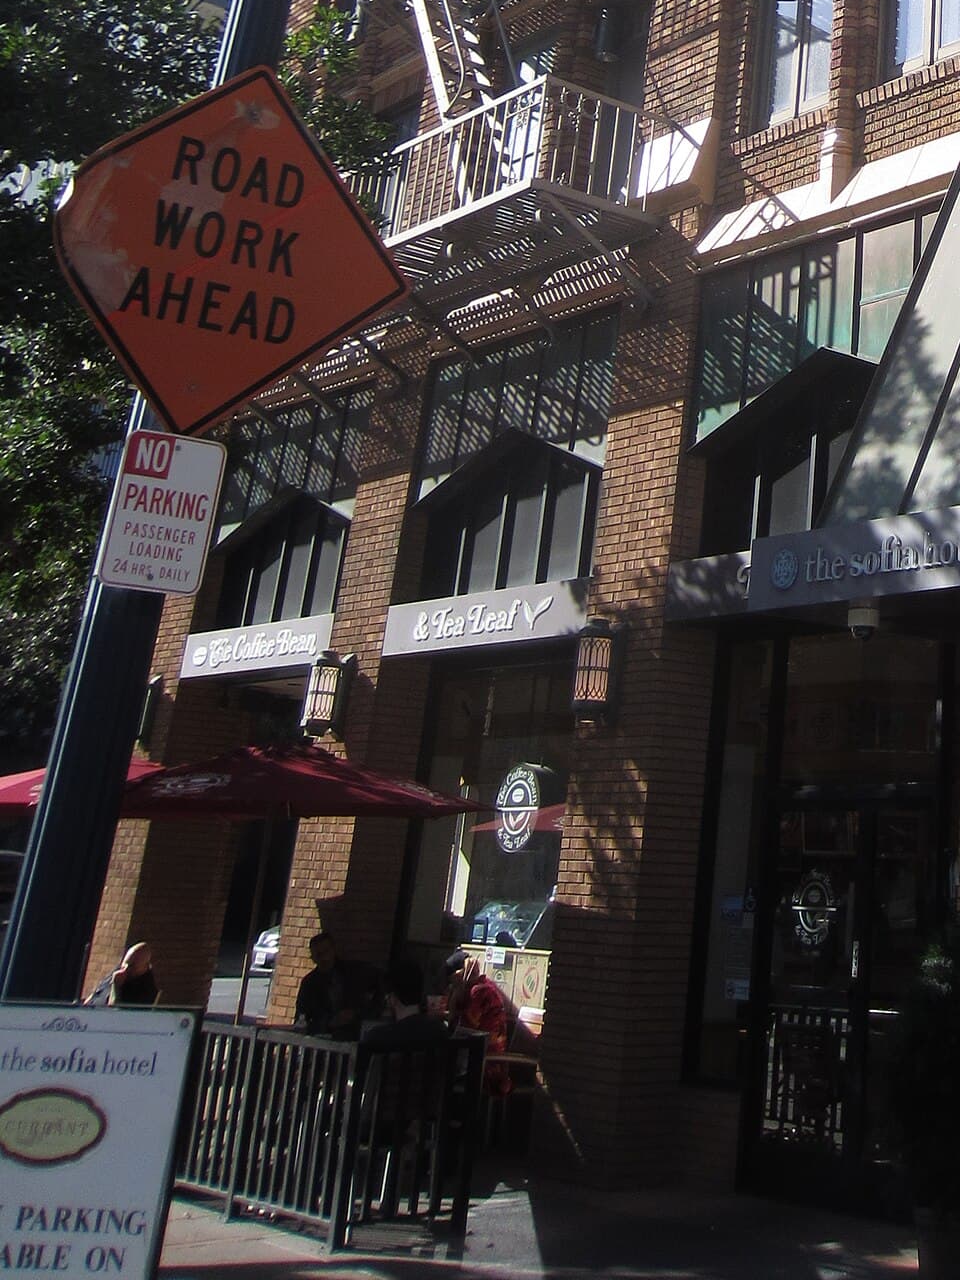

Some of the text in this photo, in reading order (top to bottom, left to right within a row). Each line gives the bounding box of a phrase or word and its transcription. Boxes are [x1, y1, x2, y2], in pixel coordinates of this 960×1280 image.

[171, 136, 305, 209] ROAD
[154, 199, 299, 278] WORK
[119, 267, 296, 345] AHEAD
[135, 438, 171, 473] NO
[123, 484, 209, 522] PARKING
[124, 522, 196, 545] PASSENGER
[129, 541, 184, 562] LOADING
[112, 558, 128, 573] 24
[160, 566, 191, 582] DAILY
[804, 547, 846, 583] the
[850, 535, 919, 577] sofia
[413, 600, 522, 641] & Tea Leaf
[209, 628, 317, 668] The Coffee Bean
[506, 767, 528, 785] Coffee
[527, 770, 538, 806] Bean
[0, 1045, 158, 1077] the sofia hotel
[15, 1205, 147, 1236] PARKING
[85, 1245, 127, 1273] ON
